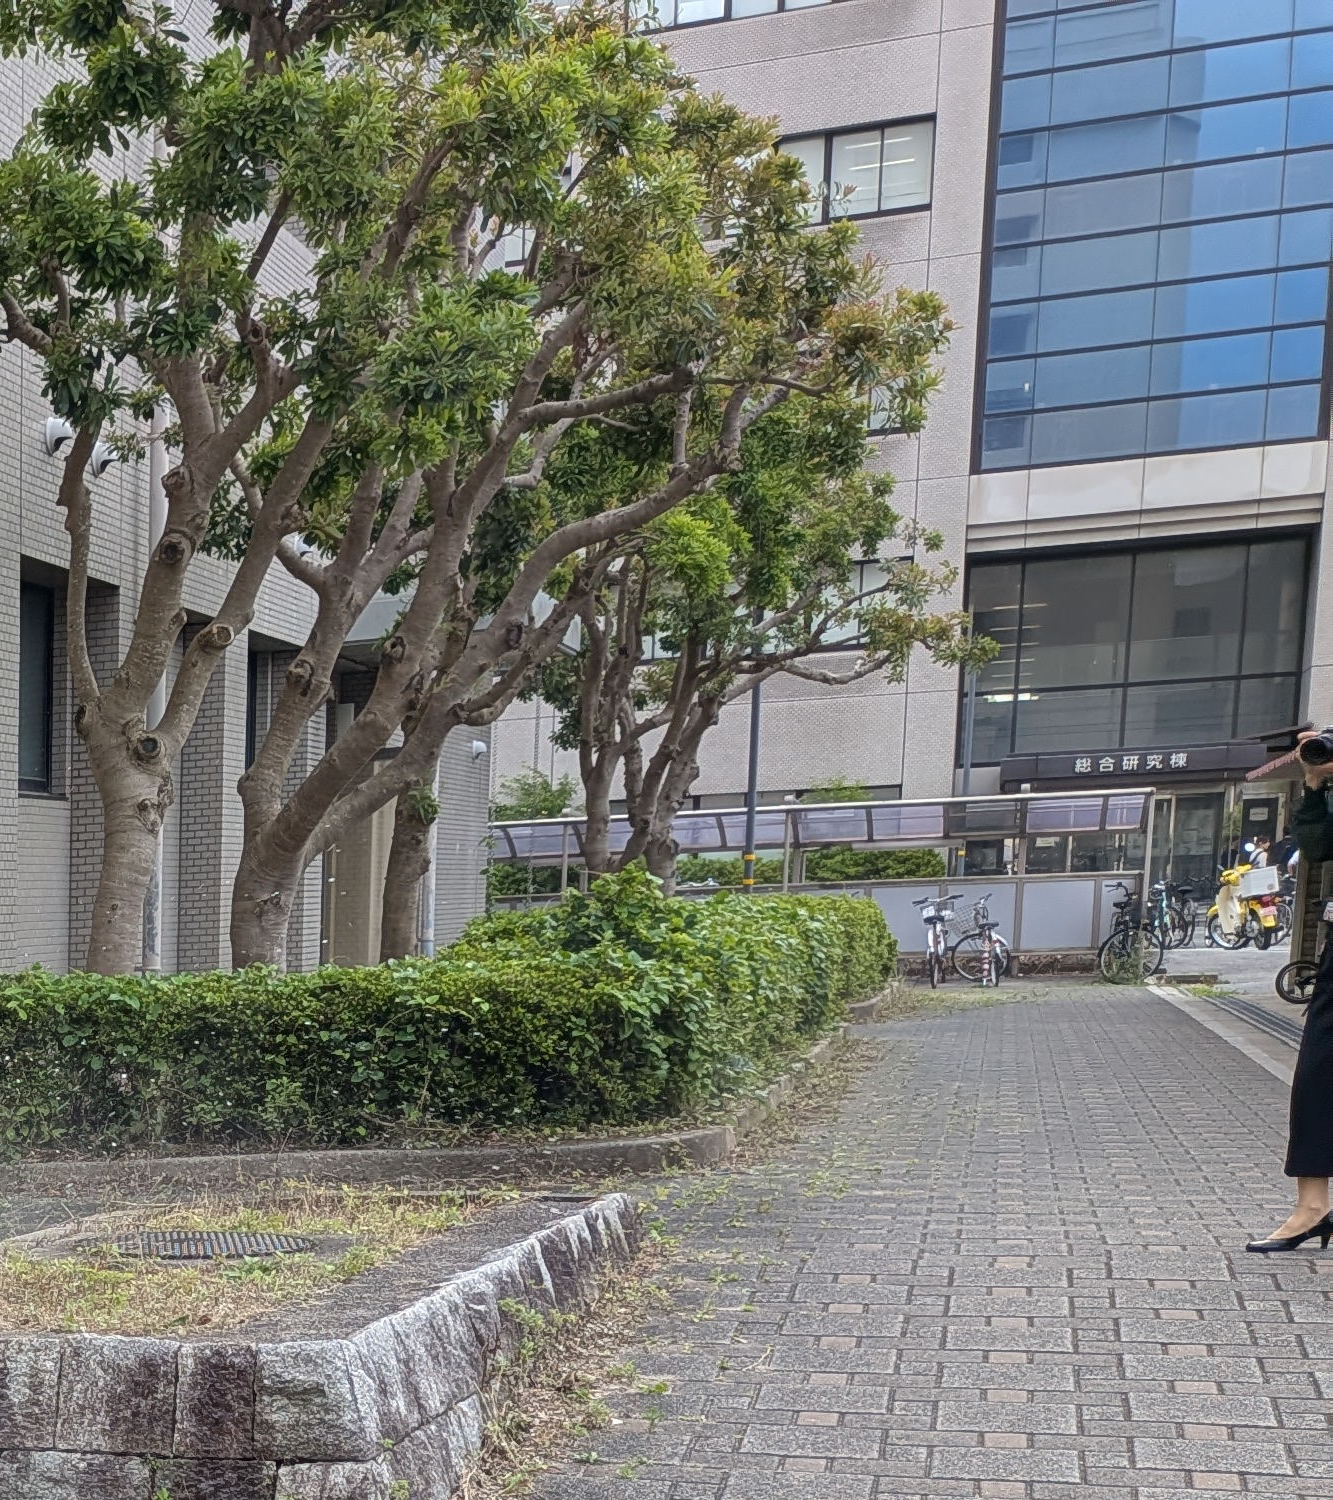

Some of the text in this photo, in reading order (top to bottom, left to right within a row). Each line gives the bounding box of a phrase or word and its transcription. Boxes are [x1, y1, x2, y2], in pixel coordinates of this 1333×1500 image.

[1074, 753, 1188, 773] 総合研究棟
